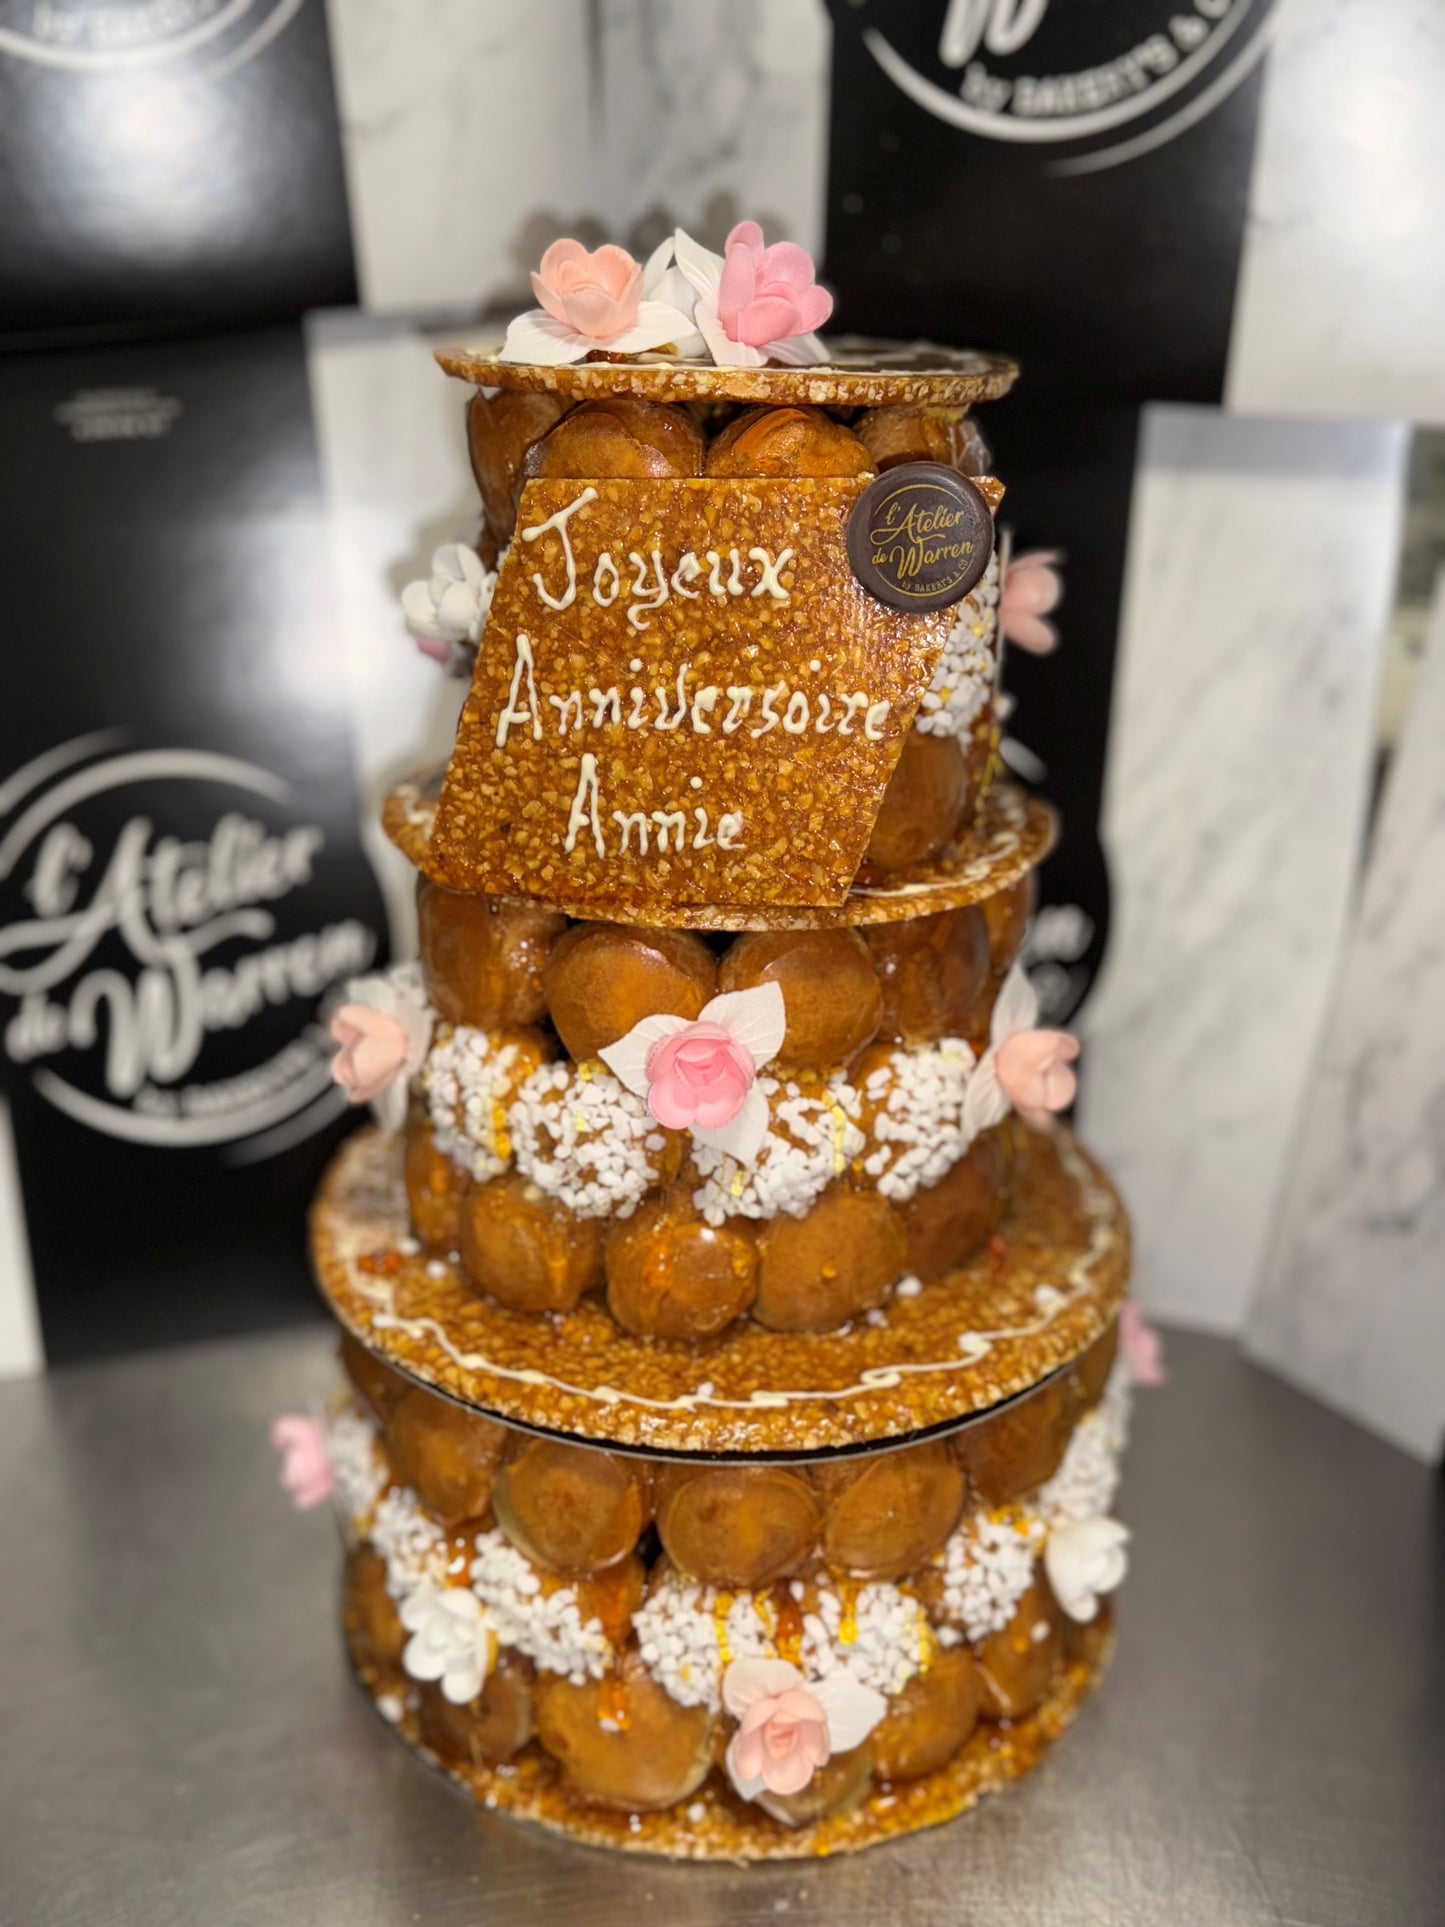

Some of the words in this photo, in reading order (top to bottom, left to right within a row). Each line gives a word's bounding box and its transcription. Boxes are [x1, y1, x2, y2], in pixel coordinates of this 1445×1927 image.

[522, 487, 794, 630] Joyeux
[870, 502, 964, 545] l'Atelier
[872, 547, 888, 565] de
[889, 540, 973, 579] Warren
[564, 753, 745, 858] Annie
